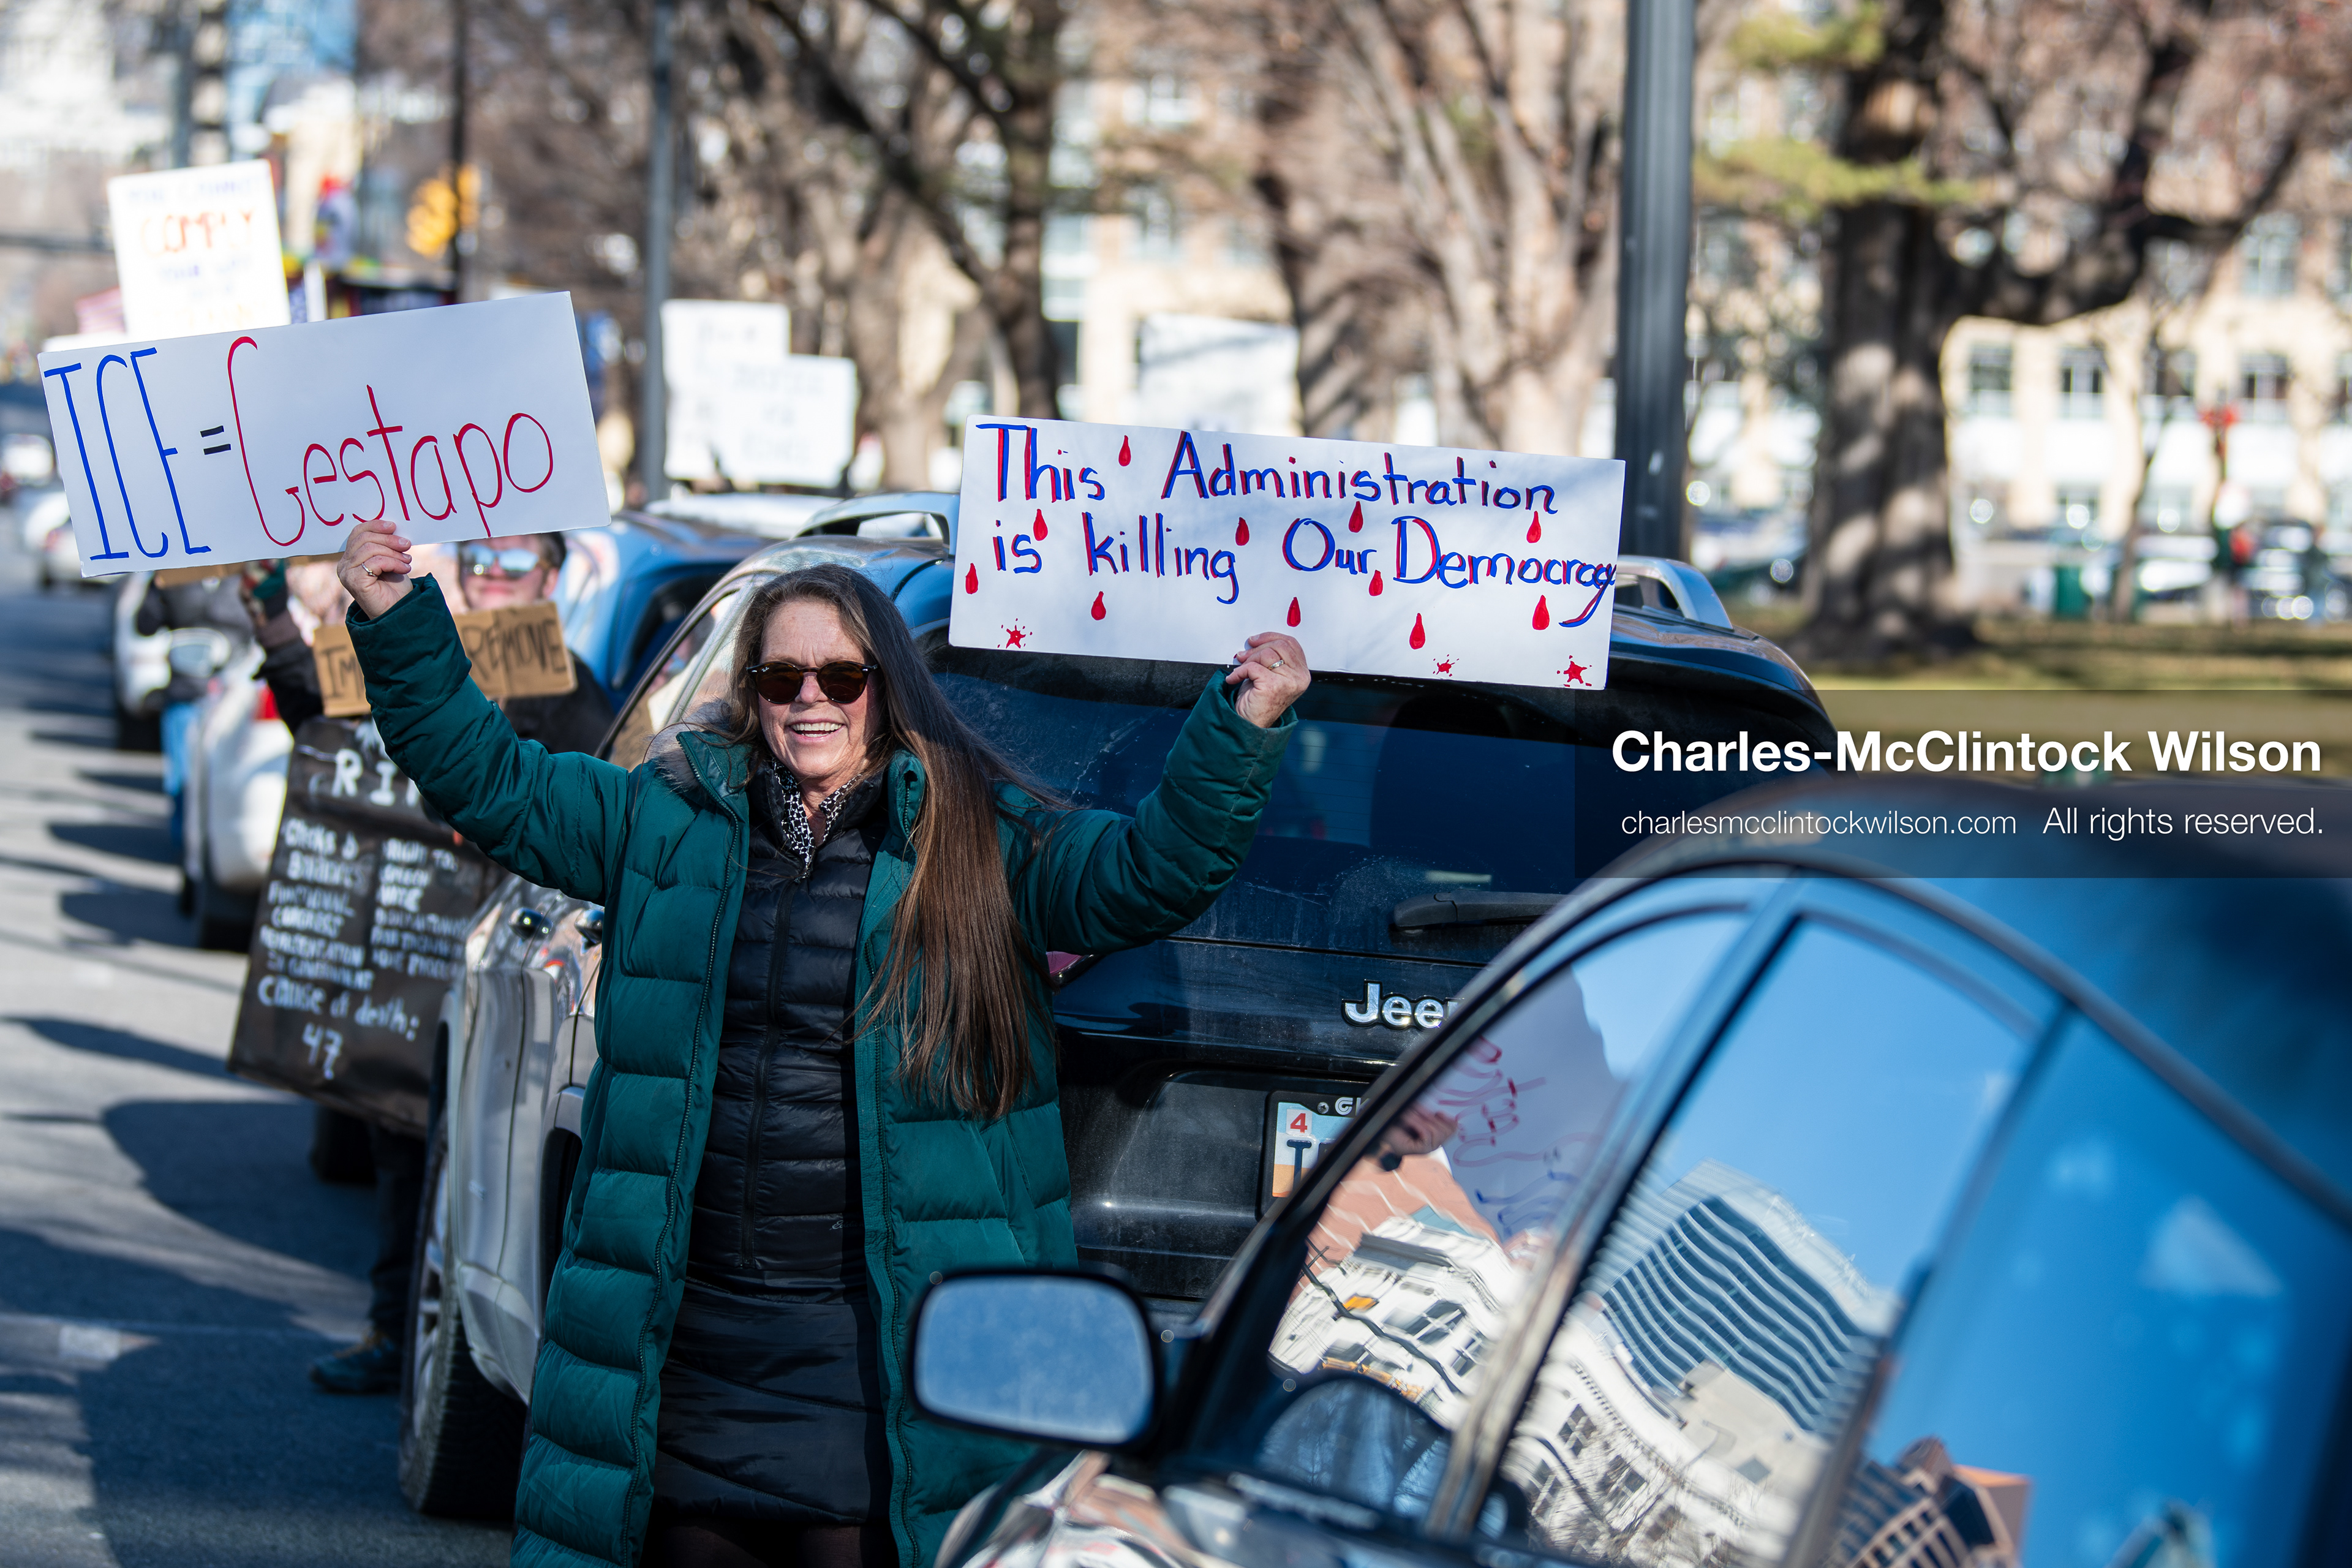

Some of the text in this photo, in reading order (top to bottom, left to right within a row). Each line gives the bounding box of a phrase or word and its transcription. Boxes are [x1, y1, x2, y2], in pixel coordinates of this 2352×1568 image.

[44, 347, 211, 560] ICE
[228, 336, 554, 547] Gestapo
[976, 423, 1558, 514] This Administration
[993, 519, 1042, 574] is
[1082, 511, 1240, 605] killing
[1282, 518, 1377, 575] Our
[461, 618, 567, 682] REMOVE
[1290, 1112, 1308, 1134] 4
